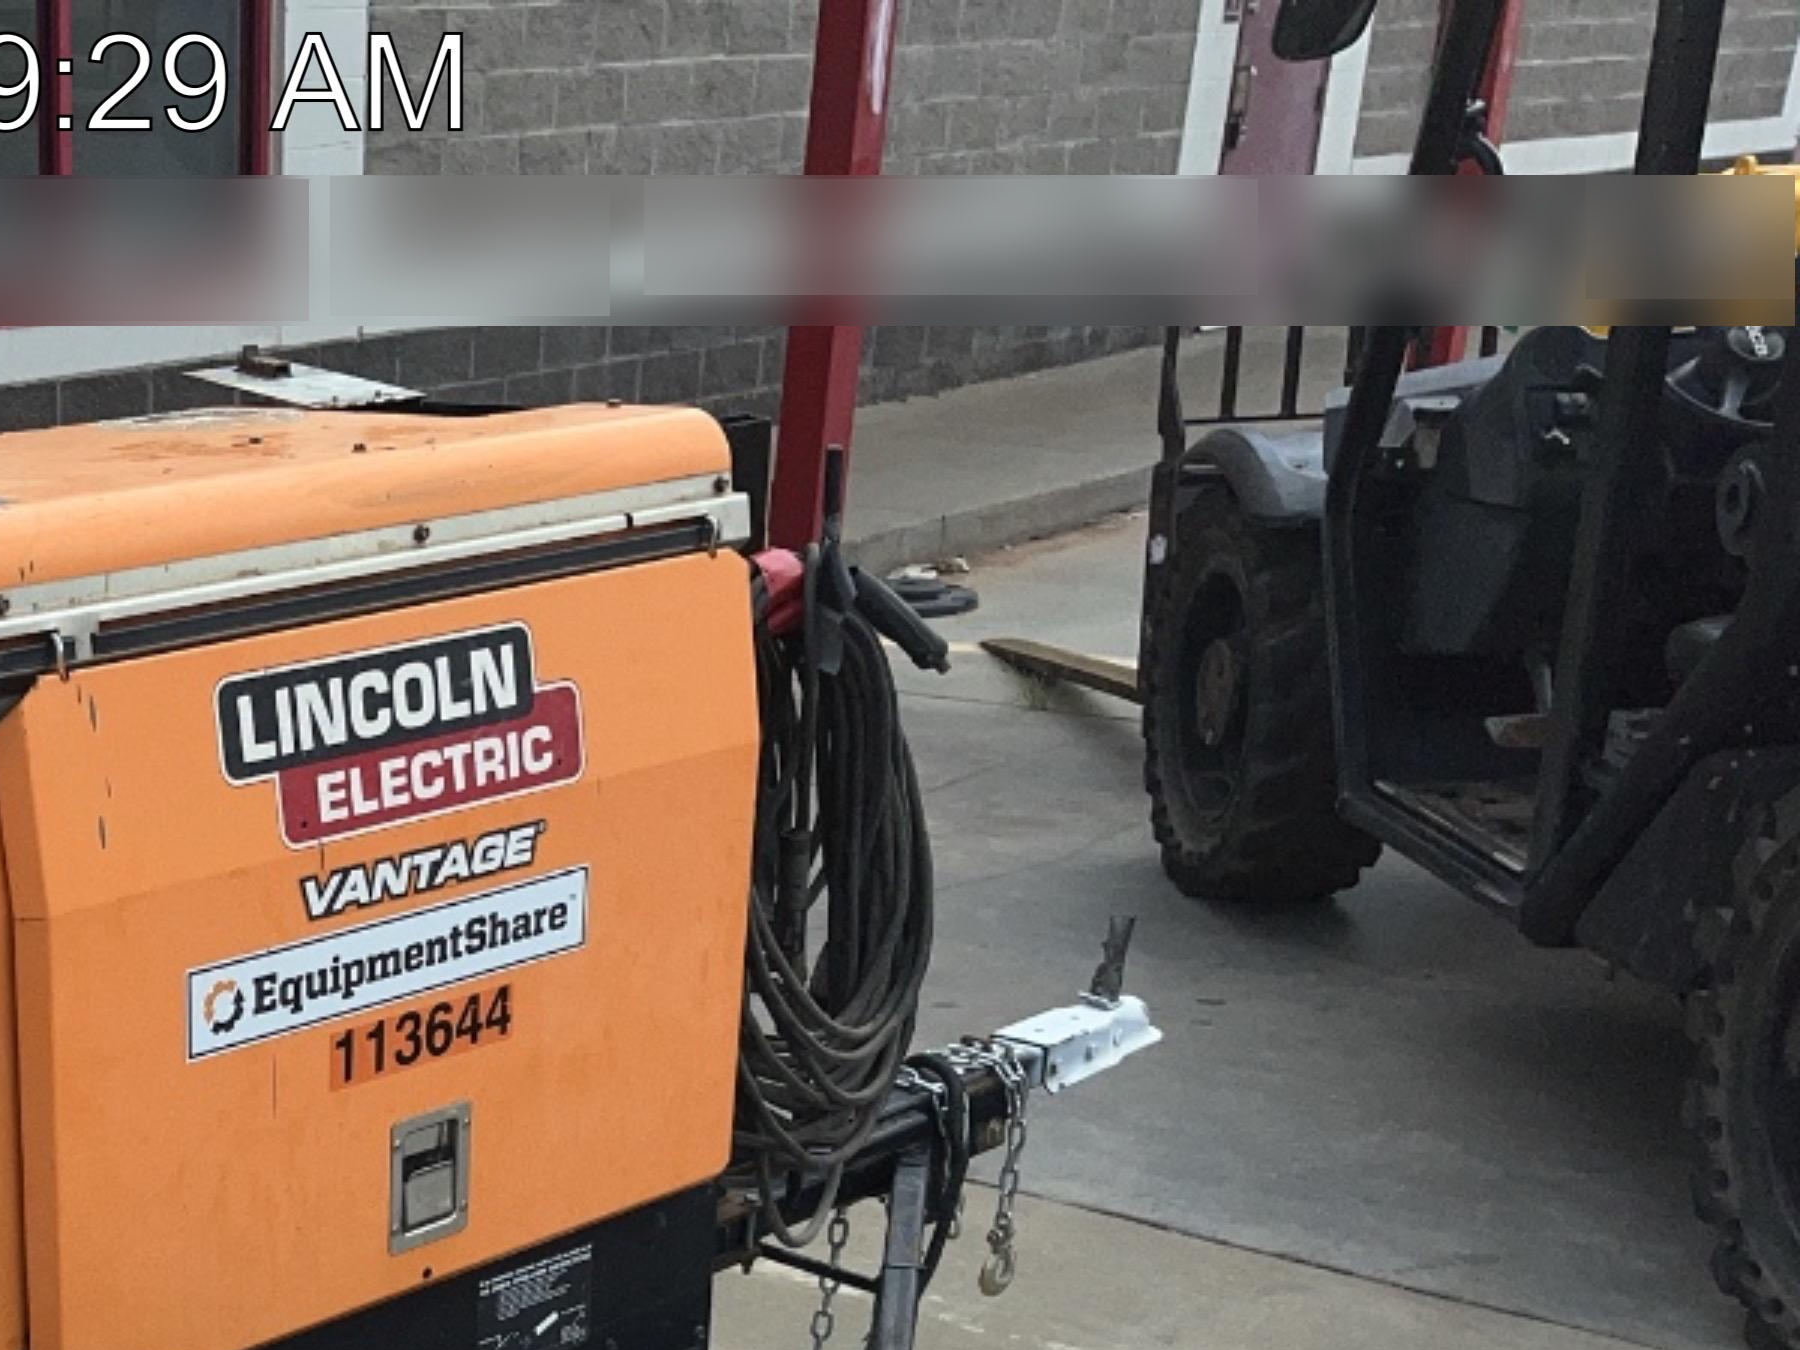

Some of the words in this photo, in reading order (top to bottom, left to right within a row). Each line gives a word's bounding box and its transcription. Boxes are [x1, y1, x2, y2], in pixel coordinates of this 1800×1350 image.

[237, 643, 518, 763] LINCOLN
[316, 725, 554, 824] ELECTRIC
[301, 824, 538, 921] VANTAGE
[252, 901, 569, 1015] EquipmentShare
[334, 984, 512, 1083] 113644
